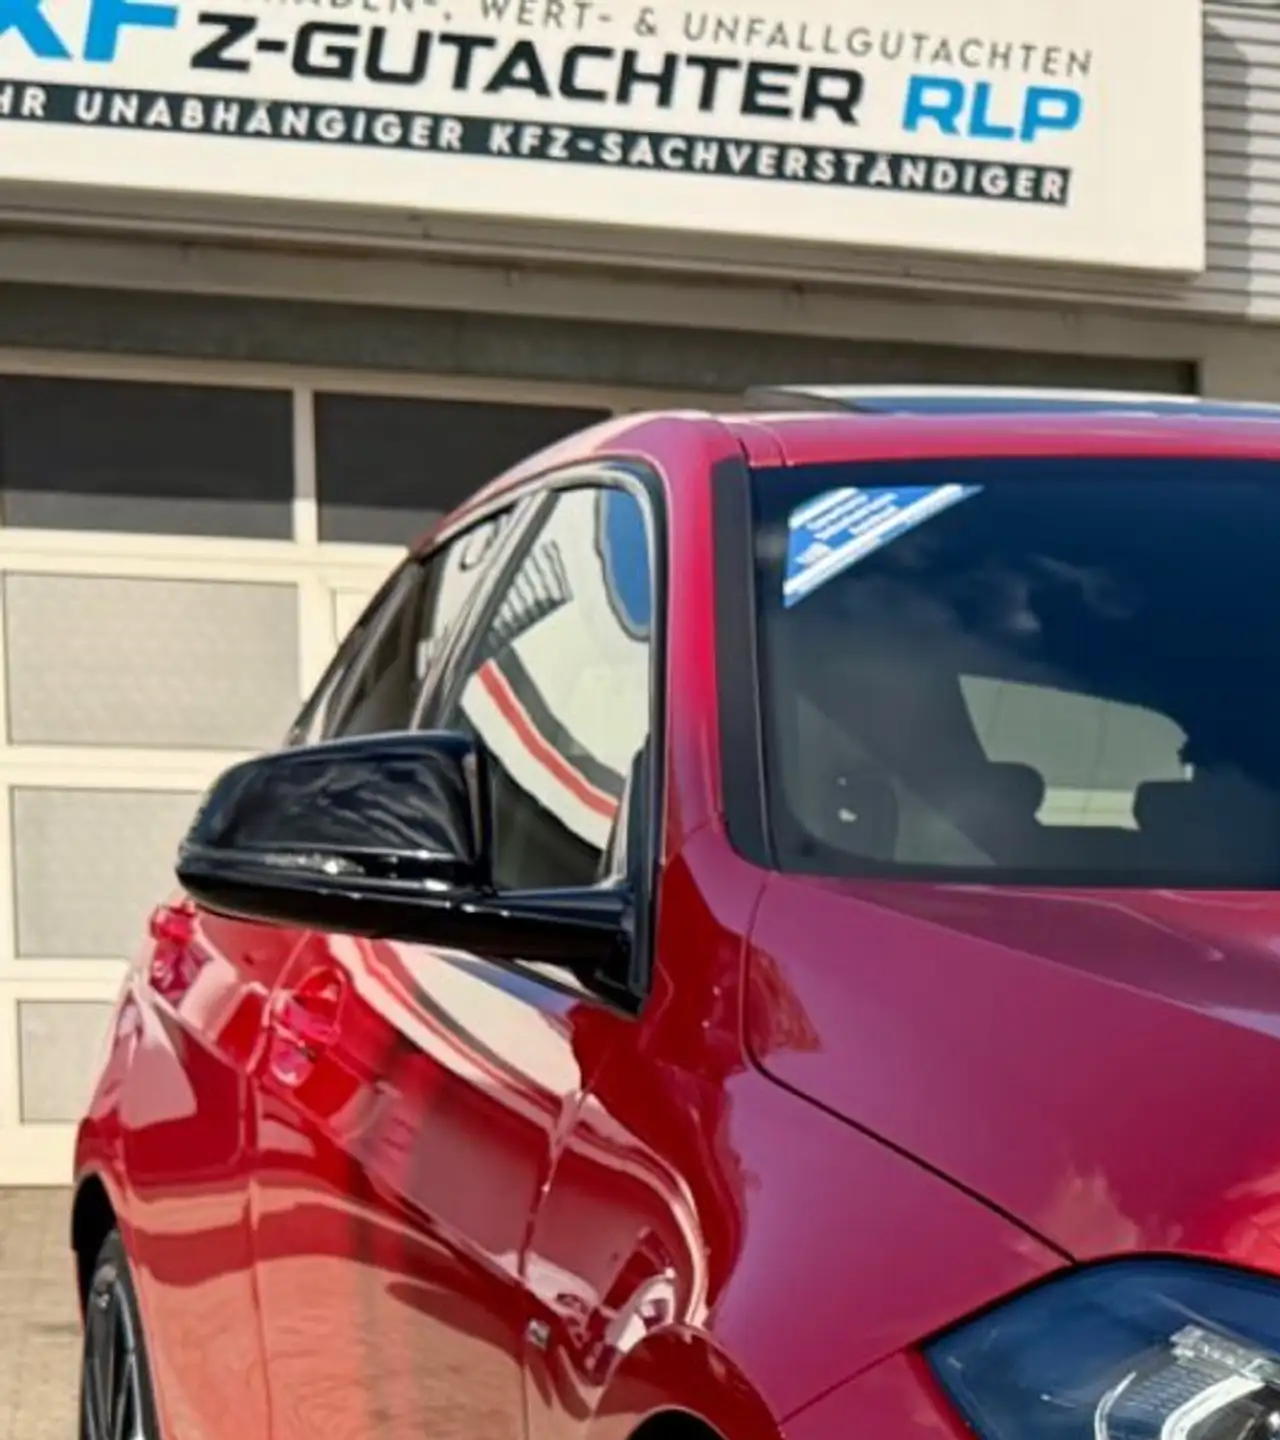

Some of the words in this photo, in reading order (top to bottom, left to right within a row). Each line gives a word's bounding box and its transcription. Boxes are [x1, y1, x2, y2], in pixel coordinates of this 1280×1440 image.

[190, 12, 865, 127] Z-GUTACHTER
[902, 74, 1082, 143] RLP
[633, 8, 659, 37] &
[682, 11, 1093, 77] UNFALLGUTACHTEN
[75, 89, 465, 151] UNABHÄNGIGER
[488, 122, 1065, 201] KFZ-SACHVERSTÄNDIGER
